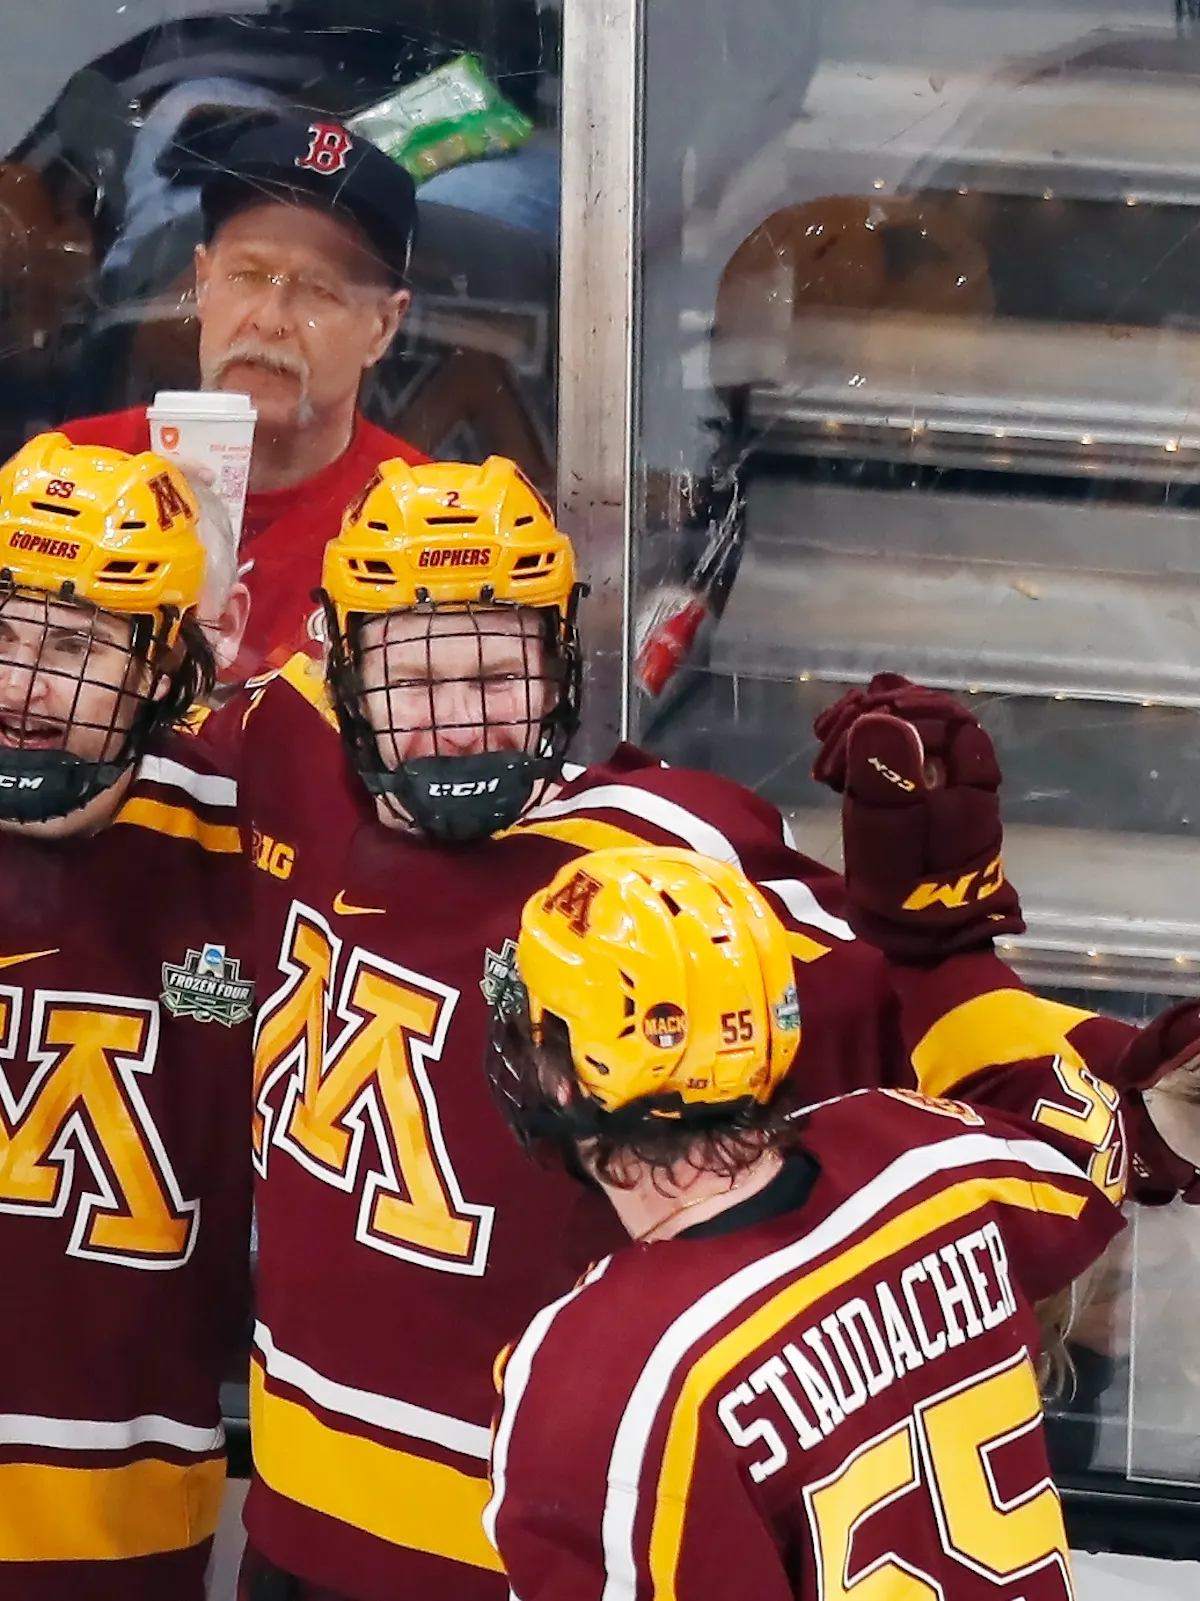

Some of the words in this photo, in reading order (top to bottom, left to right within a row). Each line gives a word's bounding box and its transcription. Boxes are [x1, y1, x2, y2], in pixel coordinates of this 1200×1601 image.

[294, 121, 353, 176] B
[146, 471, 194, 532] M
[445, 490, 461, 508] 2
[10, 529, 82, 560] GOPHERS
[417, 547, 493, 568] GOPHERS
[427, 777, 500, 797] CCM
[901, 855, 1004, 911] CM
[169, 972, 218, 996] FROZEN
[216, 984, 250, 1001] FOUR
[720, 1010, 754, 1045] 55
[253, 899, 495, 1277] M
[716, 1220, 1018, 1485] STAUDACHER
[802, 1344, 1077, 1601] 55
